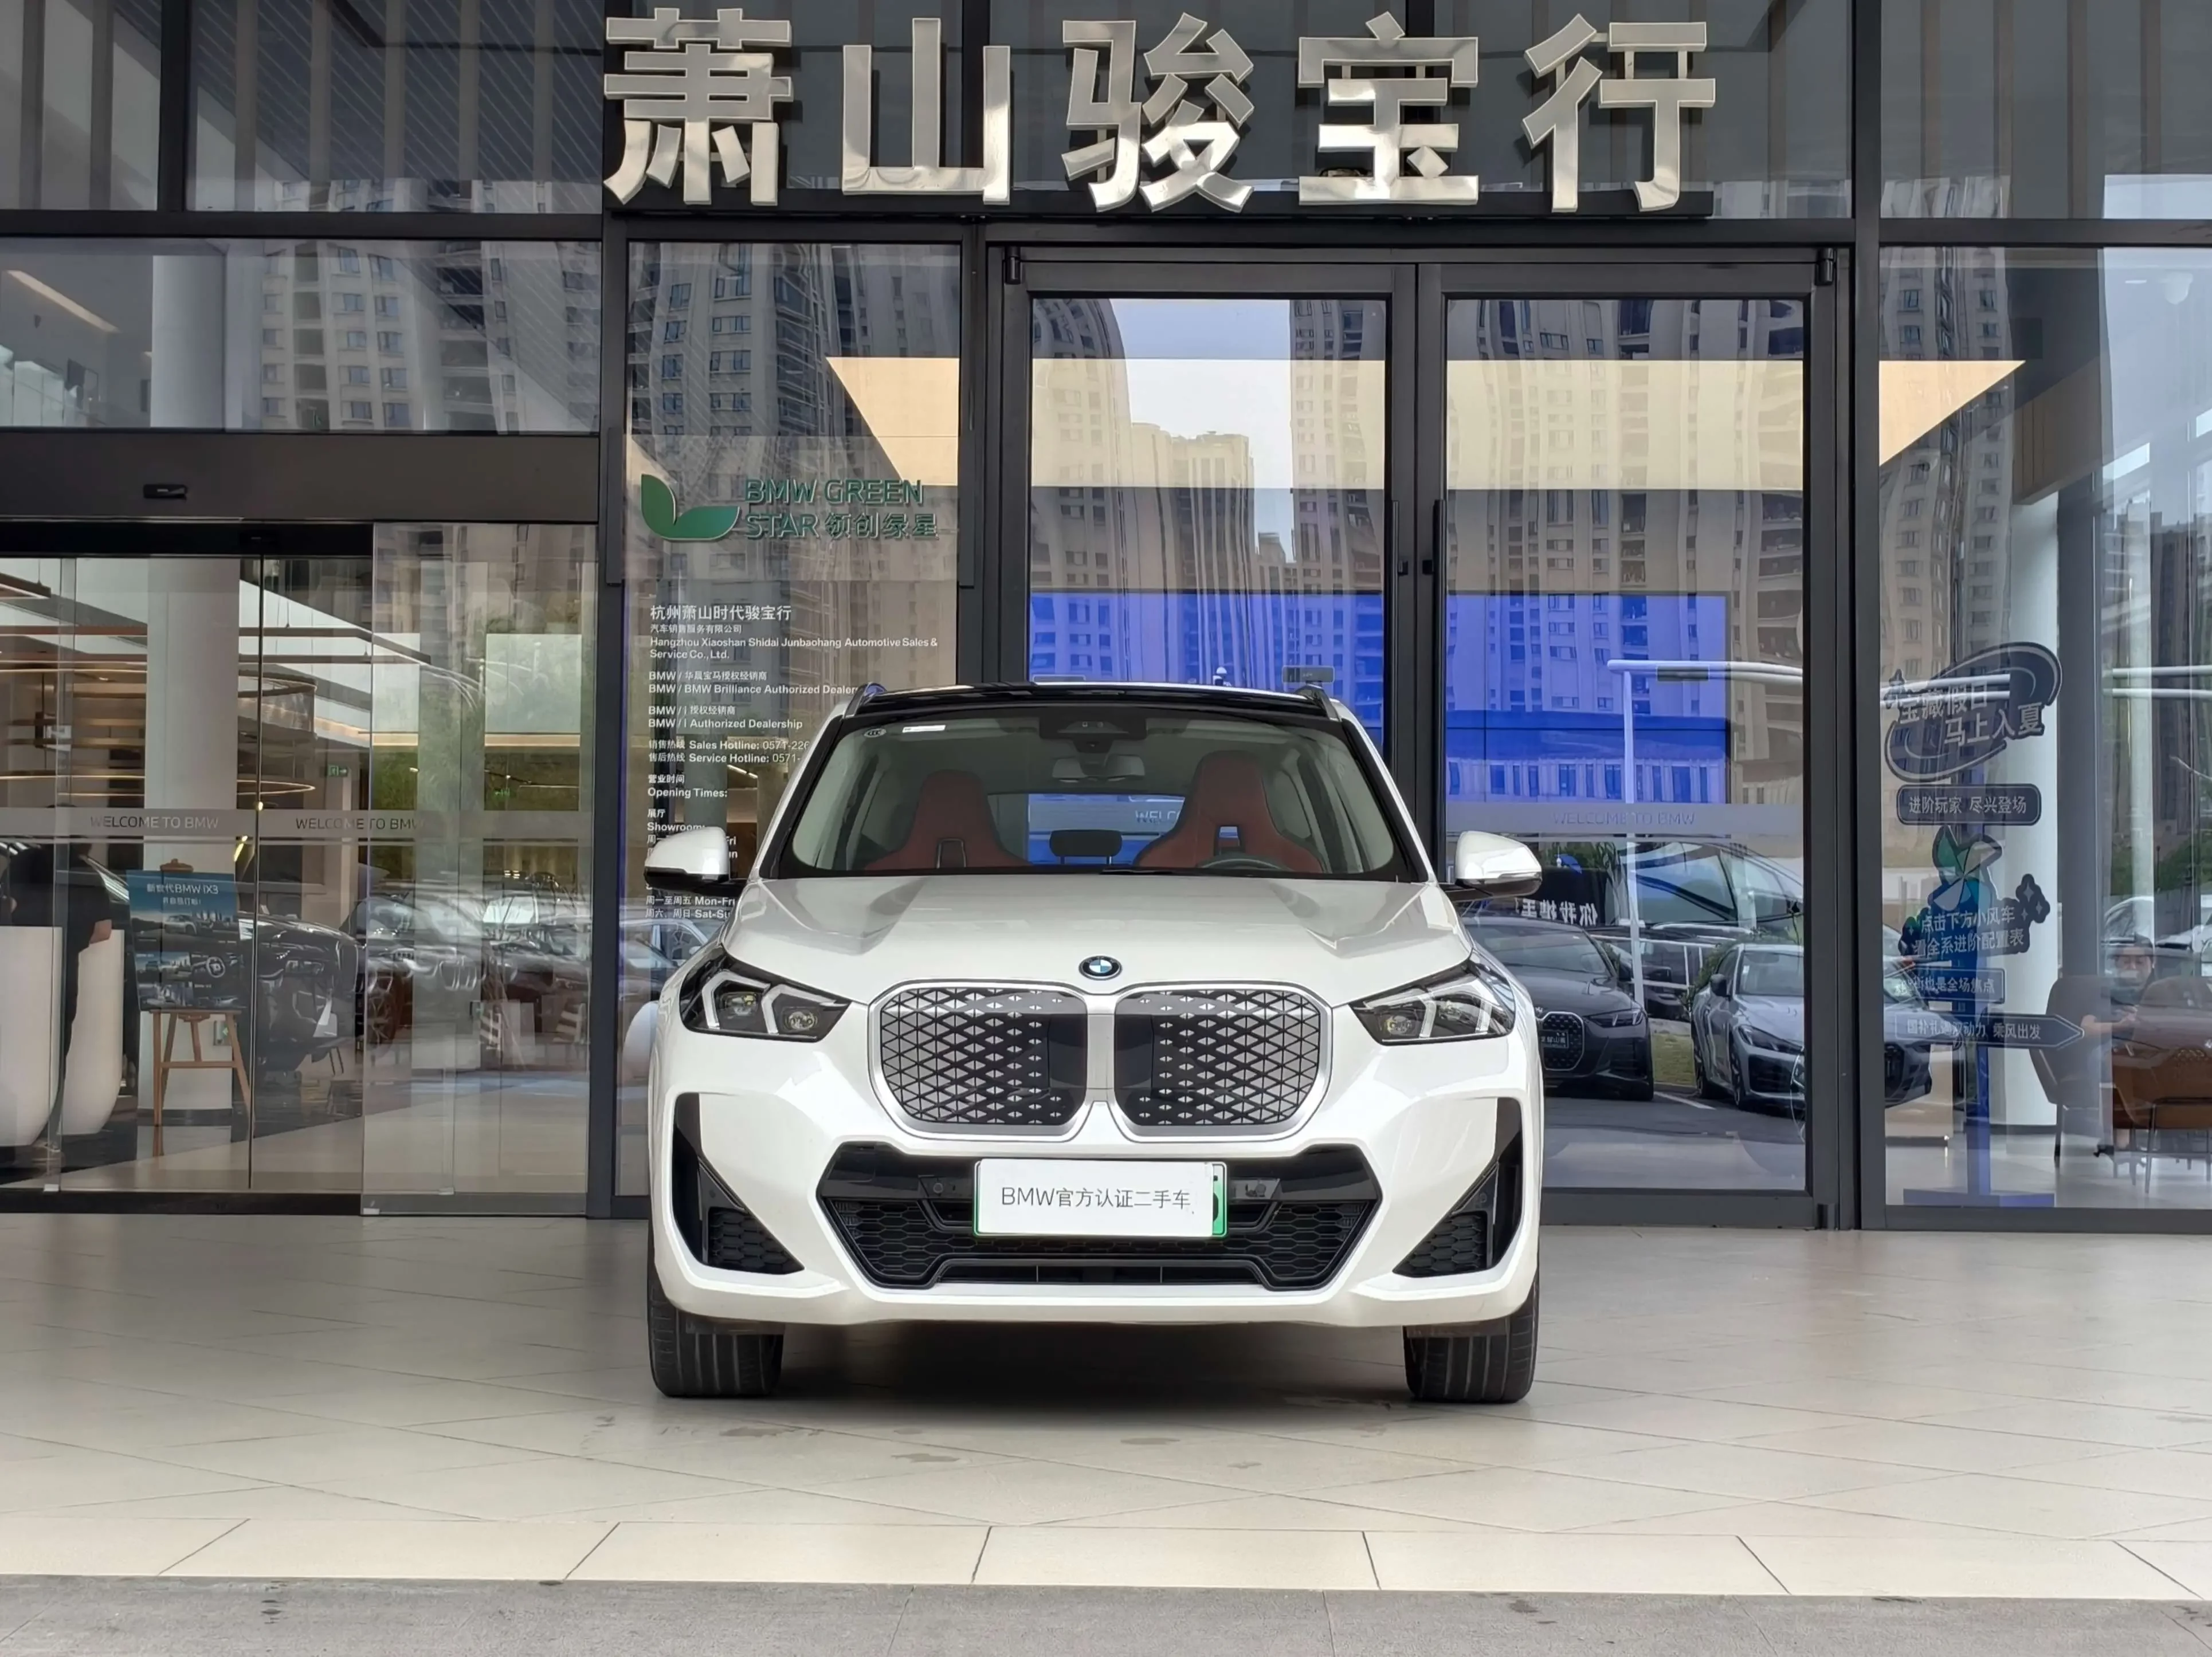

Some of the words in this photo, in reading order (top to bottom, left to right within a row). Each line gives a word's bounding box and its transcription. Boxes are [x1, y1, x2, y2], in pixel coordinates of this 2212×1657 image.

[603, 8, 1716, 213] 萧山骏宝行
[745, 479, 817, 504] BMW
[824, 479, 924, 505] GREEN
[745, 513, 821, 539] STAR
[650, 605, 791, 621] 杭州萧山时代骏宝行
[650, 624, 742, 633] 汽车销售服务有限公司
[650, 637, 699, 647] Hangzhou
[701, 637, 746, 646] Xiaoshan
[748, 637, 779, 647] Shidai
[782, 637, 841, 648] Junbaohang
[845, 638, 901, 647] Automotive
[903, 637, 929, 647] Sales
[931, 638, 938, 646] &
[650, 650, 687, 658] Service
[711, 650, 729, 658] Ltd.
[649, 671, 676, 680] BMW
[649, 684, 675, 693] BMW
[684, 684, 711, 693] BMW
[714, 684, 762, 693] Brilliance
[764, 685, 819, 694] Authorized
[649, 706, 676, 714] BMW
[690, 705, 735, 715] 授权经销商
[649, 718, 676, 728] BMW
[690, 719, 746, 728] Authorized
[749, 720, 803, 731] Dealership
[689, 740, 716, 749] Sales
[720, 741, 759, 750] Hotline:
[689, 753, 727, 762] Service
[730, 753, 769, 763] Hotline:
[648, 775, 685, 783] 营业时间
[648, 787, 691, 798] Opening
[693, 788, 728, 798] Times:
[1909, 796, 1962, 814] 进阶玩家
[1970, 795, 2027, 814] 尽兴登场
[647, 808, 665, 818] 展厅
[1552, 812, 1627, 825] WELCOME
[1658, 812, 1695, 825] BMW
[91, 816, 159, 828] WELCOME
[161, 817, 181, 828] TO
[185, 817, 218, 829] BMW
[296, 818, 364, 830] WELCOME
[369, 818, 386, 830] TO
[646, 896, 691, 905] 周一至周五
[695, 909, 730, 918] Sat-Su
[1921, 905, 2015, 933] 点击下方小风车
[1993, 1023, 2041, 1040] 乘风出发
[1002, 1187, 1190, 1210] BMW官方认证二手车
